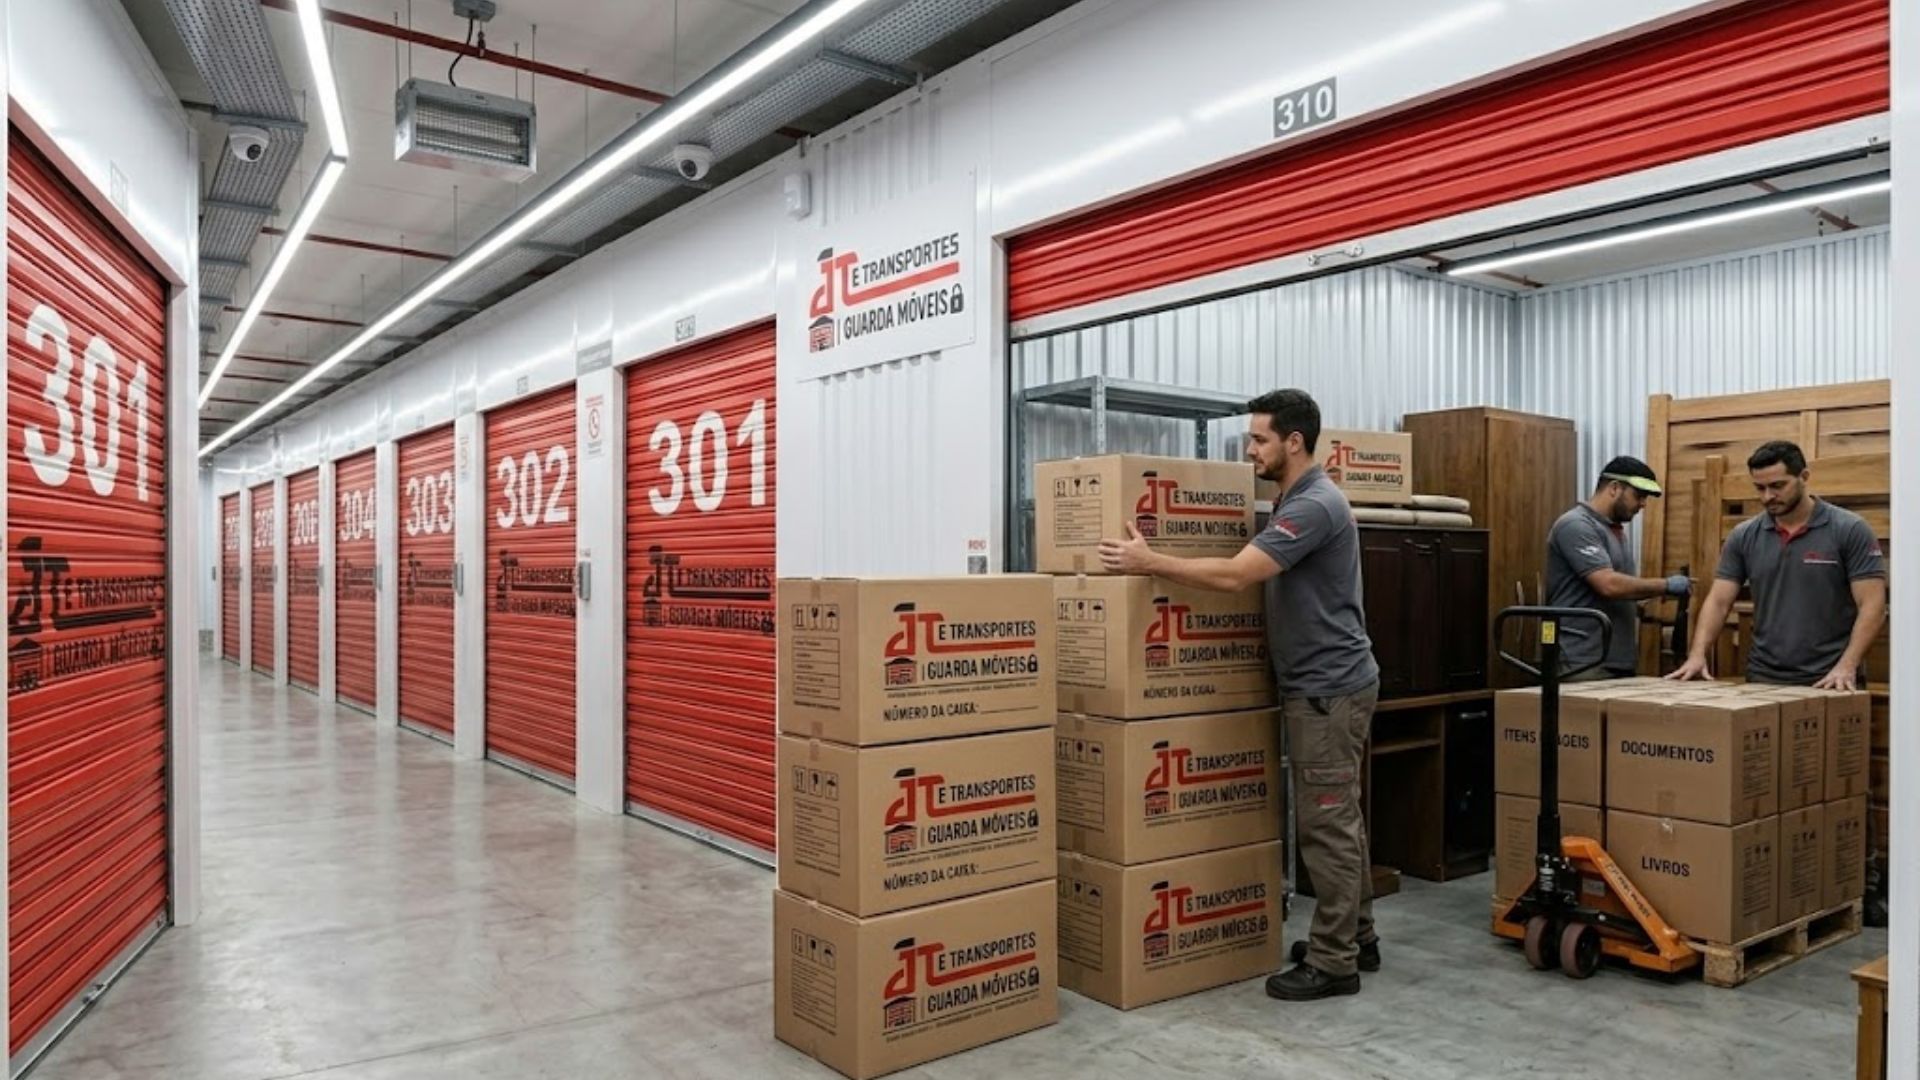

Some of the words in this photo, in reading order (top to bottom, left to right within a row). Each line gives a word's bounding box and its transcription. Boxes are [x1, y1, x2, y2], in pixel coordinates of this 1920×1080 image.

[1278, 86, 1333, 130] 310
[852, 268, 859, 287] E
[863, 233, 959, 284] TRANSPORTES
[844, 305, 894, 340] GUARDA
[898, 289, 948, 325] MÓVEIS
[24, 304, 148, 501] 301
[648, 398, 766, 516] 301
[406, 470, 455, 537] 303
[496, 445, 569, 528] 302
[340, 487, 376, 541] 304
[939, 624, 946, 640] E
[950, 620, 1036, 640] TRANSPORTES
[927, 660, 977, 680] GUARDA
[981, 654, 1026, 675] MÓVEIS
[931, 705, 945, 718] DA
[1621, 740, 1714, 764] DOCUMENTOS
[939, 787, 946, 803] E
[950, 774, 1036, 803] TRANSPORTES
[927, 824, 978, 845] GUARDA
[981, 811, 1026, 836] MÓVEIS
[884, 872, 928, 891] NÚMERO
[931, 869, 945, 883] DA
[1641, 856, 1690, 877] LIVROS
[939, 954, 946, 970] E
[950, 931, 1036, 968] TRANSPORTES
[927, 986, 978, 1014] GUARDA
[981, 974, 1026, 998] MÓVEIS
